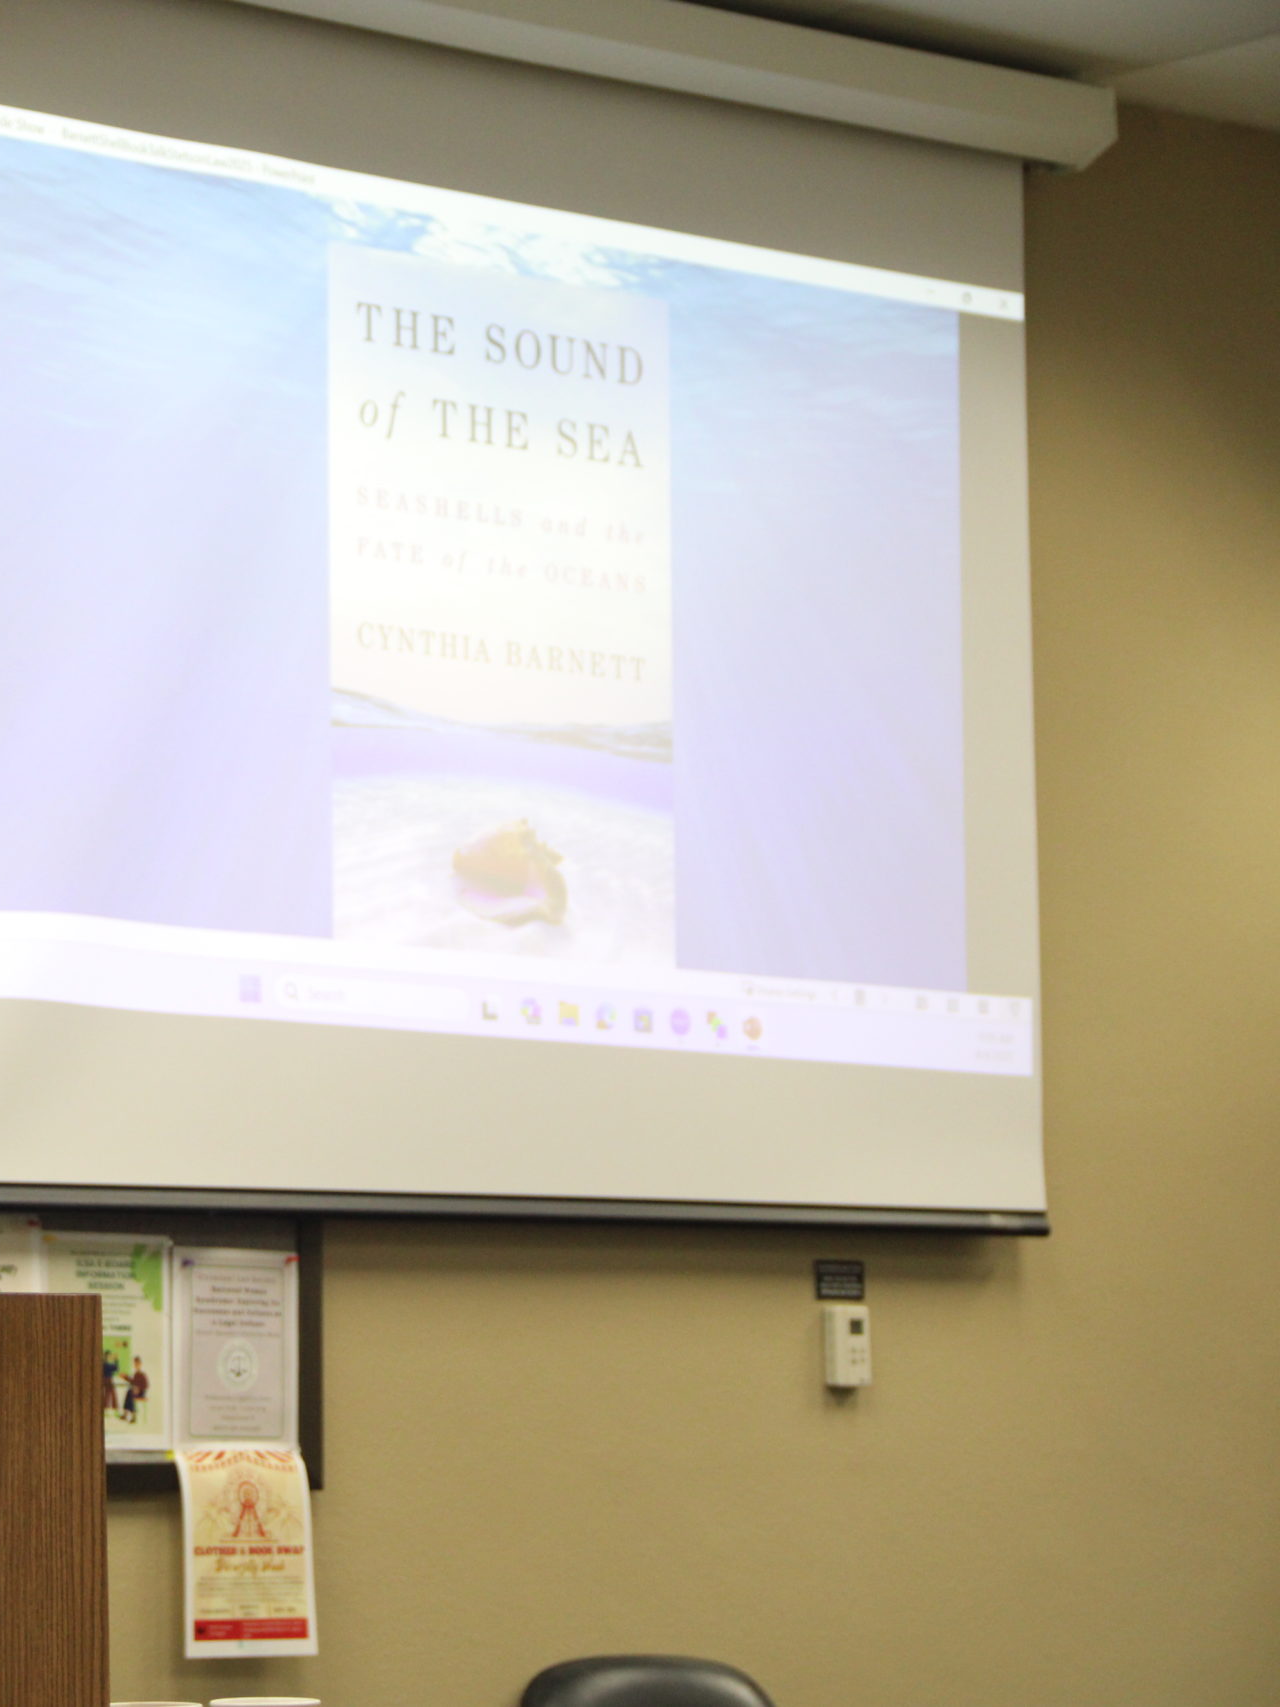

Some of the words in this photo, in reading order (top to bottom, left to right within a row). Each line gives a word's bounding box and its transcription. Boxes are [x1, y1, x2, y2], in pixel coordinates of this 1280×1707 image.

[357, 301, 456, 356] THE
[484, 323, 644, 386] SOUND
[358, 390, 406, 440] of
[432, 398, 529, 451] THE
[556, 418, 644, 469] SEA
[356, 486, 523, 528] SEASHELLS
[541, 516, 588, 538] and
[605, 522, 645, 545] the
[356, 536, 424, 565] FATE
[441, 549, 469, 574] of
[487, 553, 527, 577] the
[544, 562, 647, 595] OCEANS
[356, 621, 492, 665] CYNTHIA
[505, 640, 647, 684] BARNETT
